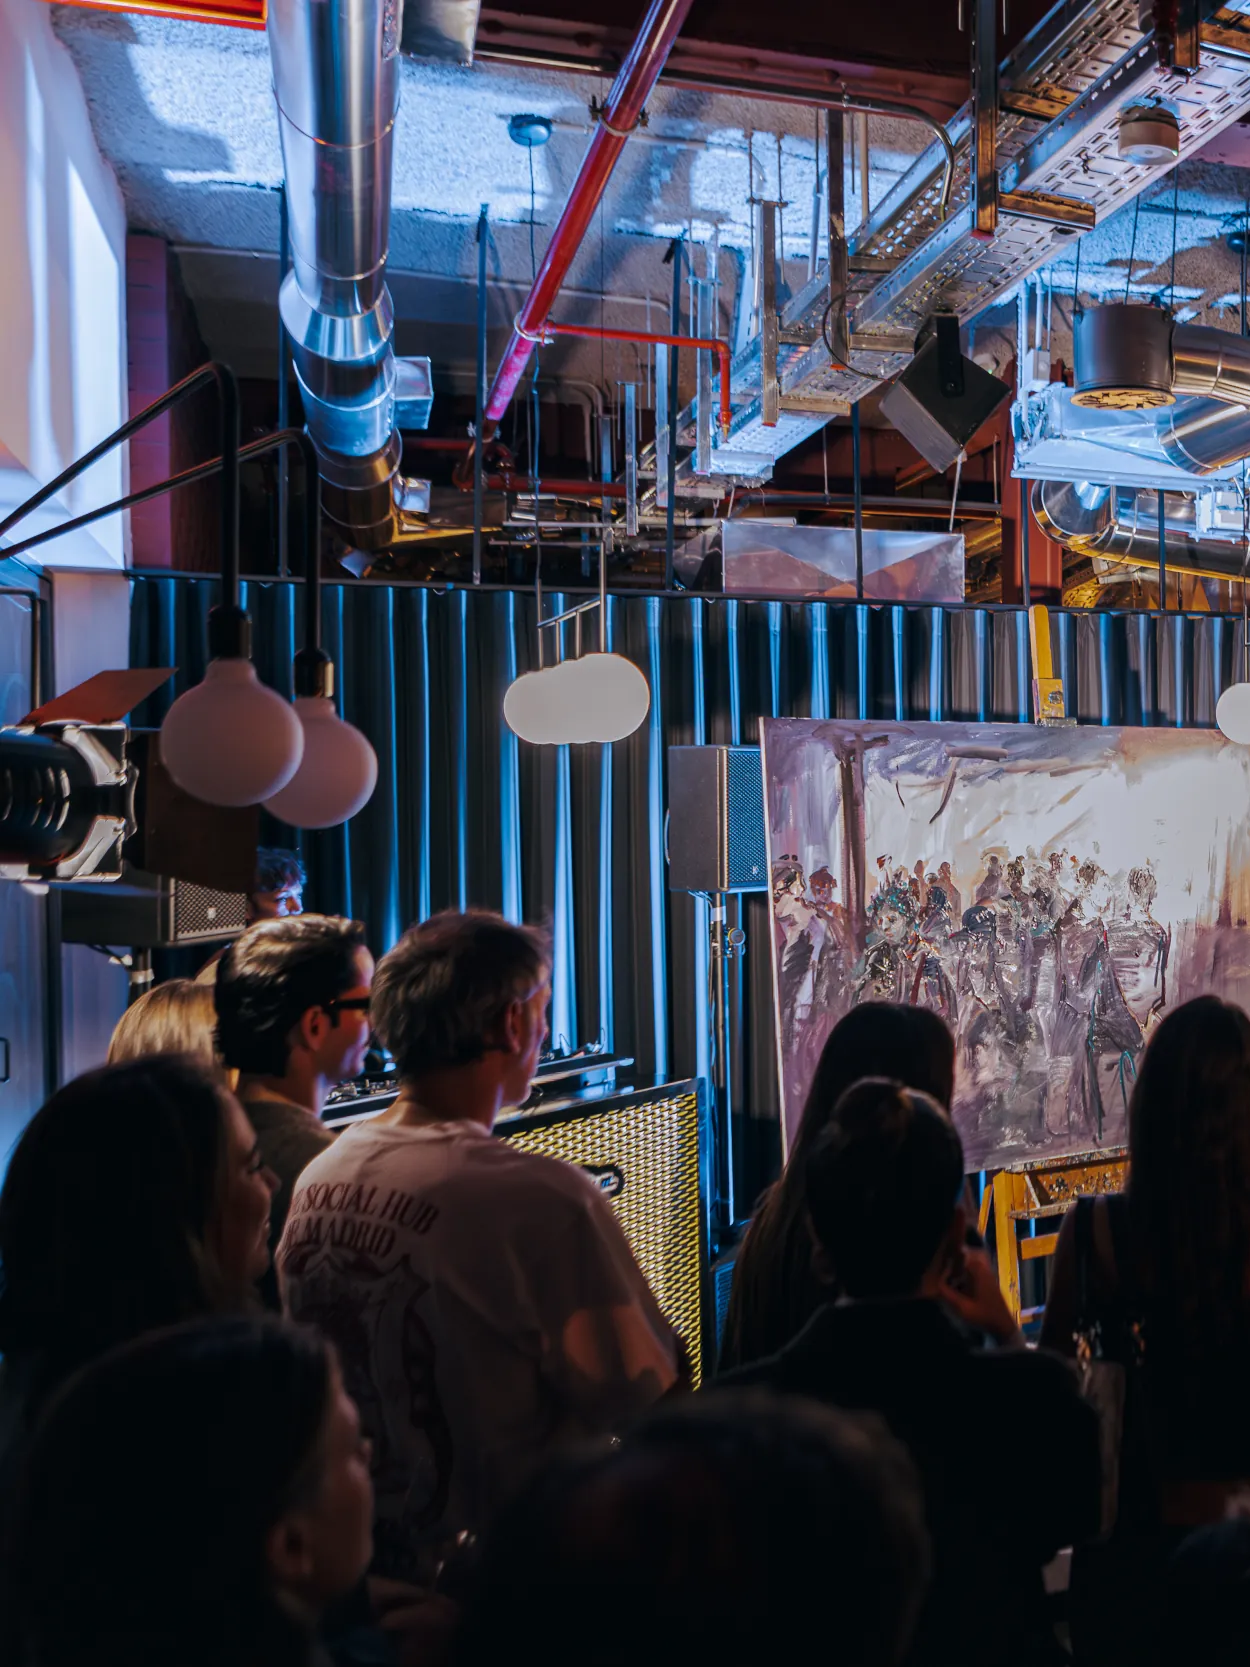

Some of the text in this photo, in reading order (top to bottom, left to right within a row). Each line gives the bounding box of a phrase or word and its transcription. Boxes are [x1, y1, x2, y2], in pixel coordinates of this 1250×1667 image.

[301, 1182, 378, 1216] SOCIAL
[379, 1186, 439, 1236] HUB
[303, 1216, 396, 1258] MADRID
